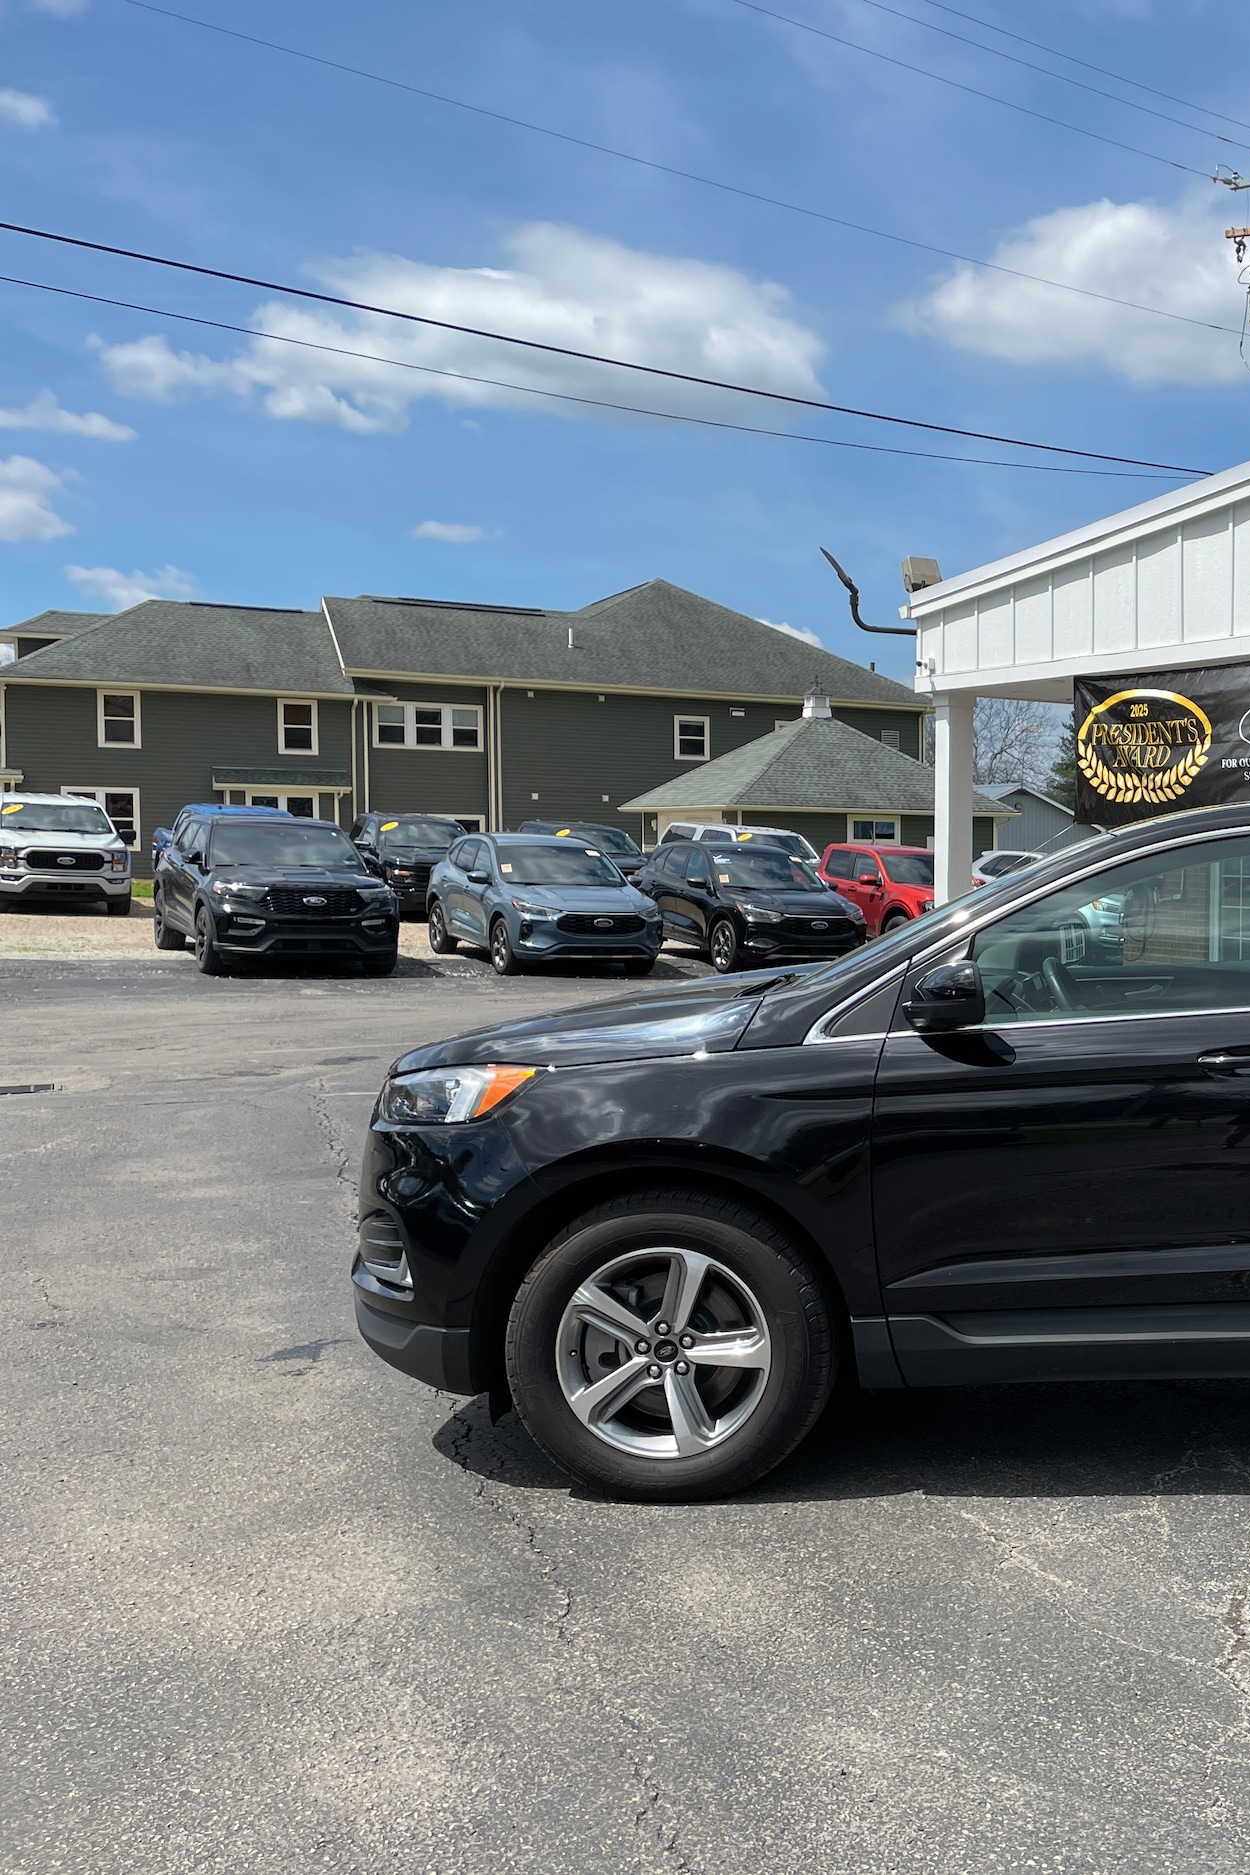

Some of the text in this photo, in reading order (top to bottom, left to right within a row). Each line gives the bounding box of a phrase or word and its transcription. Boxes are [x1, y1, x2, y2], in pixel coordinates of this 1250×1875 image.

[1130, 703, 1149, 718] 2025
[1092, 718, 1198, 745] PRESIDENT'S
[1113, 745, 1171, 768] AWARD
[1221, 758, 1238, 769] FOR
